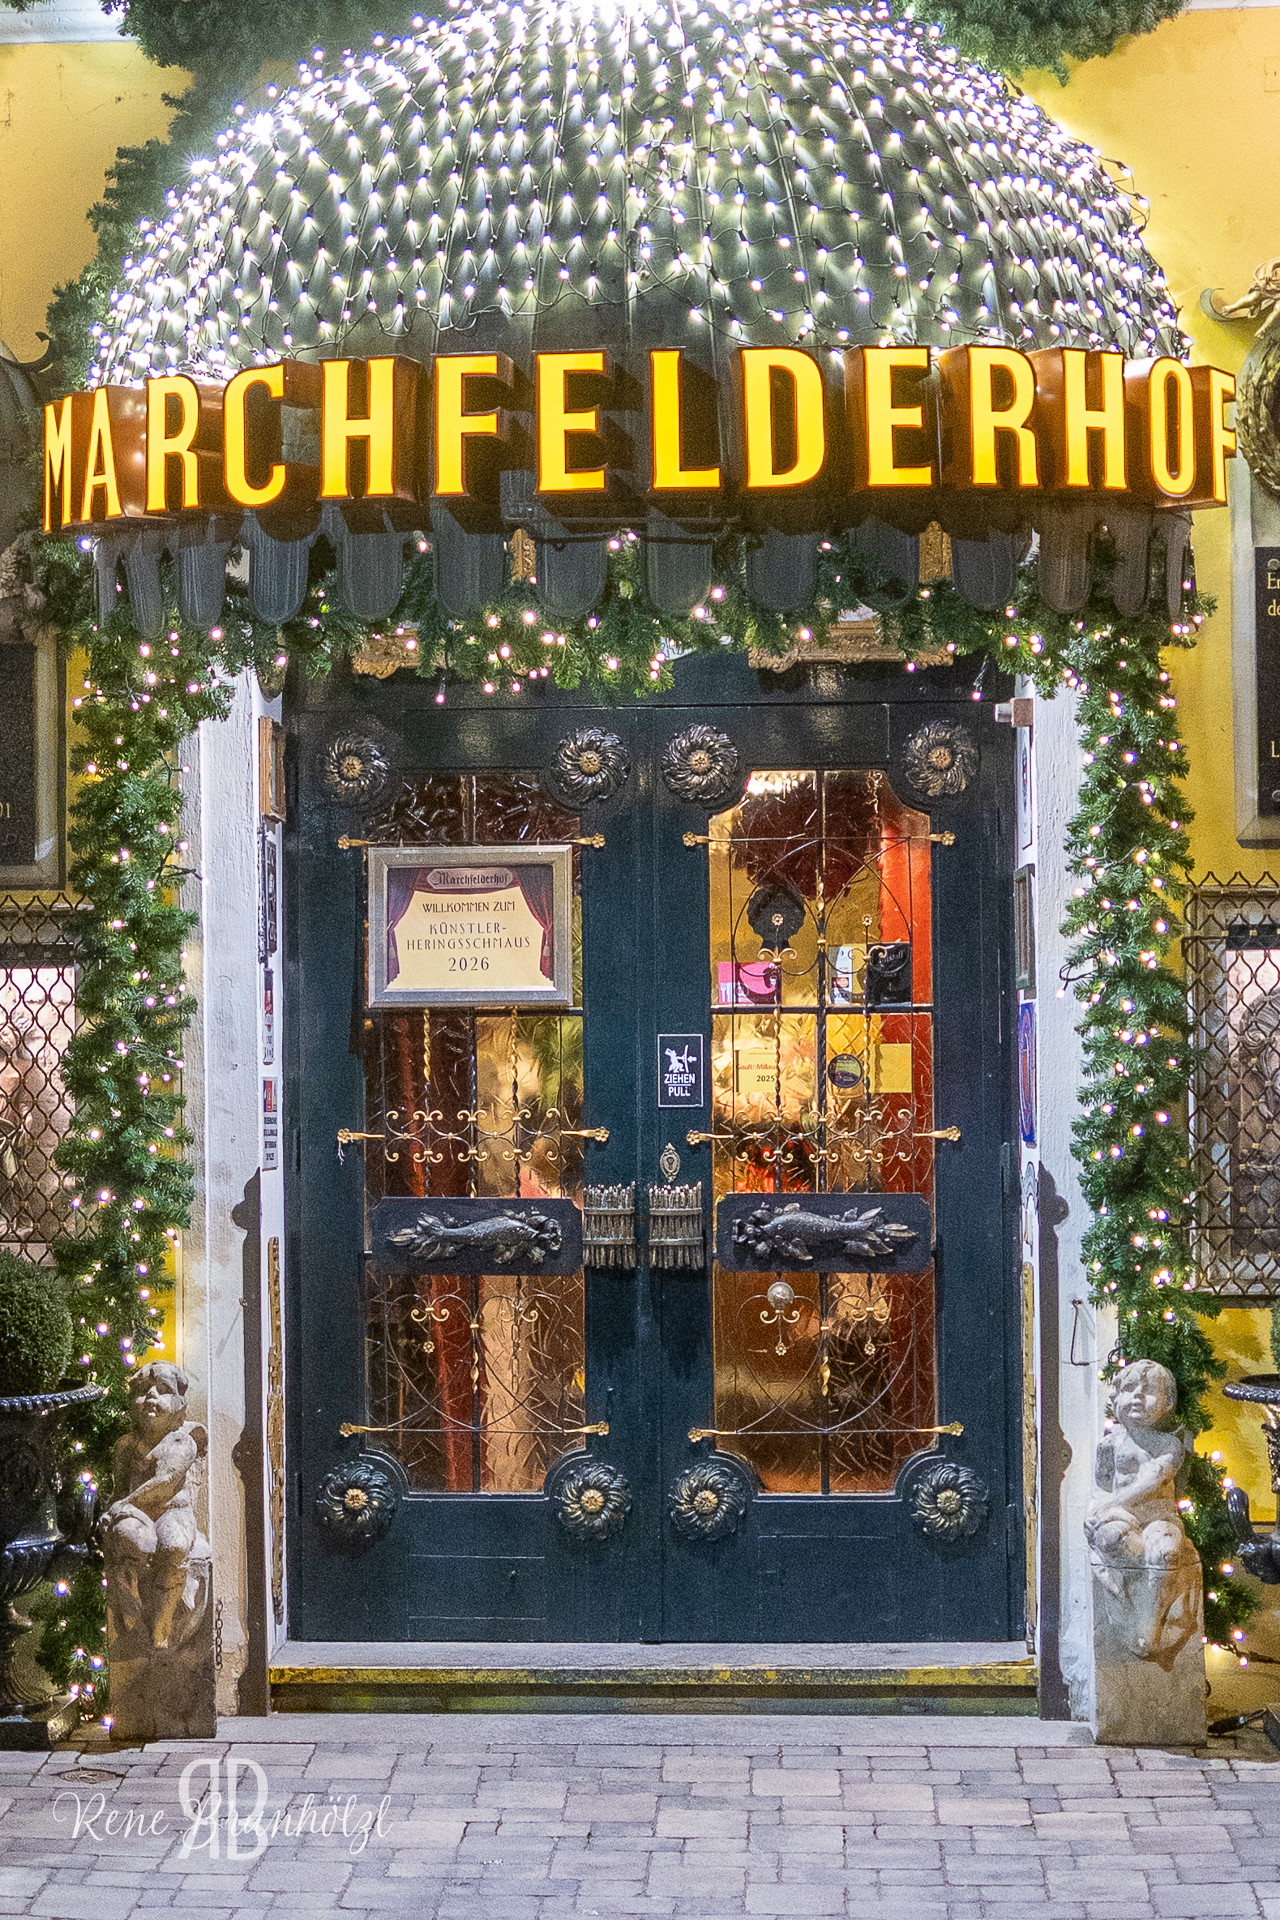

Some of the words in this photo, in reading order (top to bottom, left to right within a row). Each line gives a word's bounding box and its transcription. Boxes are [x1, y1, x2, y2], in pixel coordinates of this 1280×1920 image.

[44, 347, 1237, 533] MARCHFELDERHOF
[433, 871, 508, 886] Marchfelderhof
[422, 902, 490, 913] WILLKOMMEN
[493, 901, 515, 912] ZUM
[429, 922, 507, 935] KÜNSTLER-
[407, 936, 530, 951] HERINGSSCHMAUS
[448, 957, 490, 972] 2026
[664, 1073, 696, 1084] ZIEHEN
[756, 1074, 776, 1083] 2025
[668, 1086, 691, 1097] PULL
